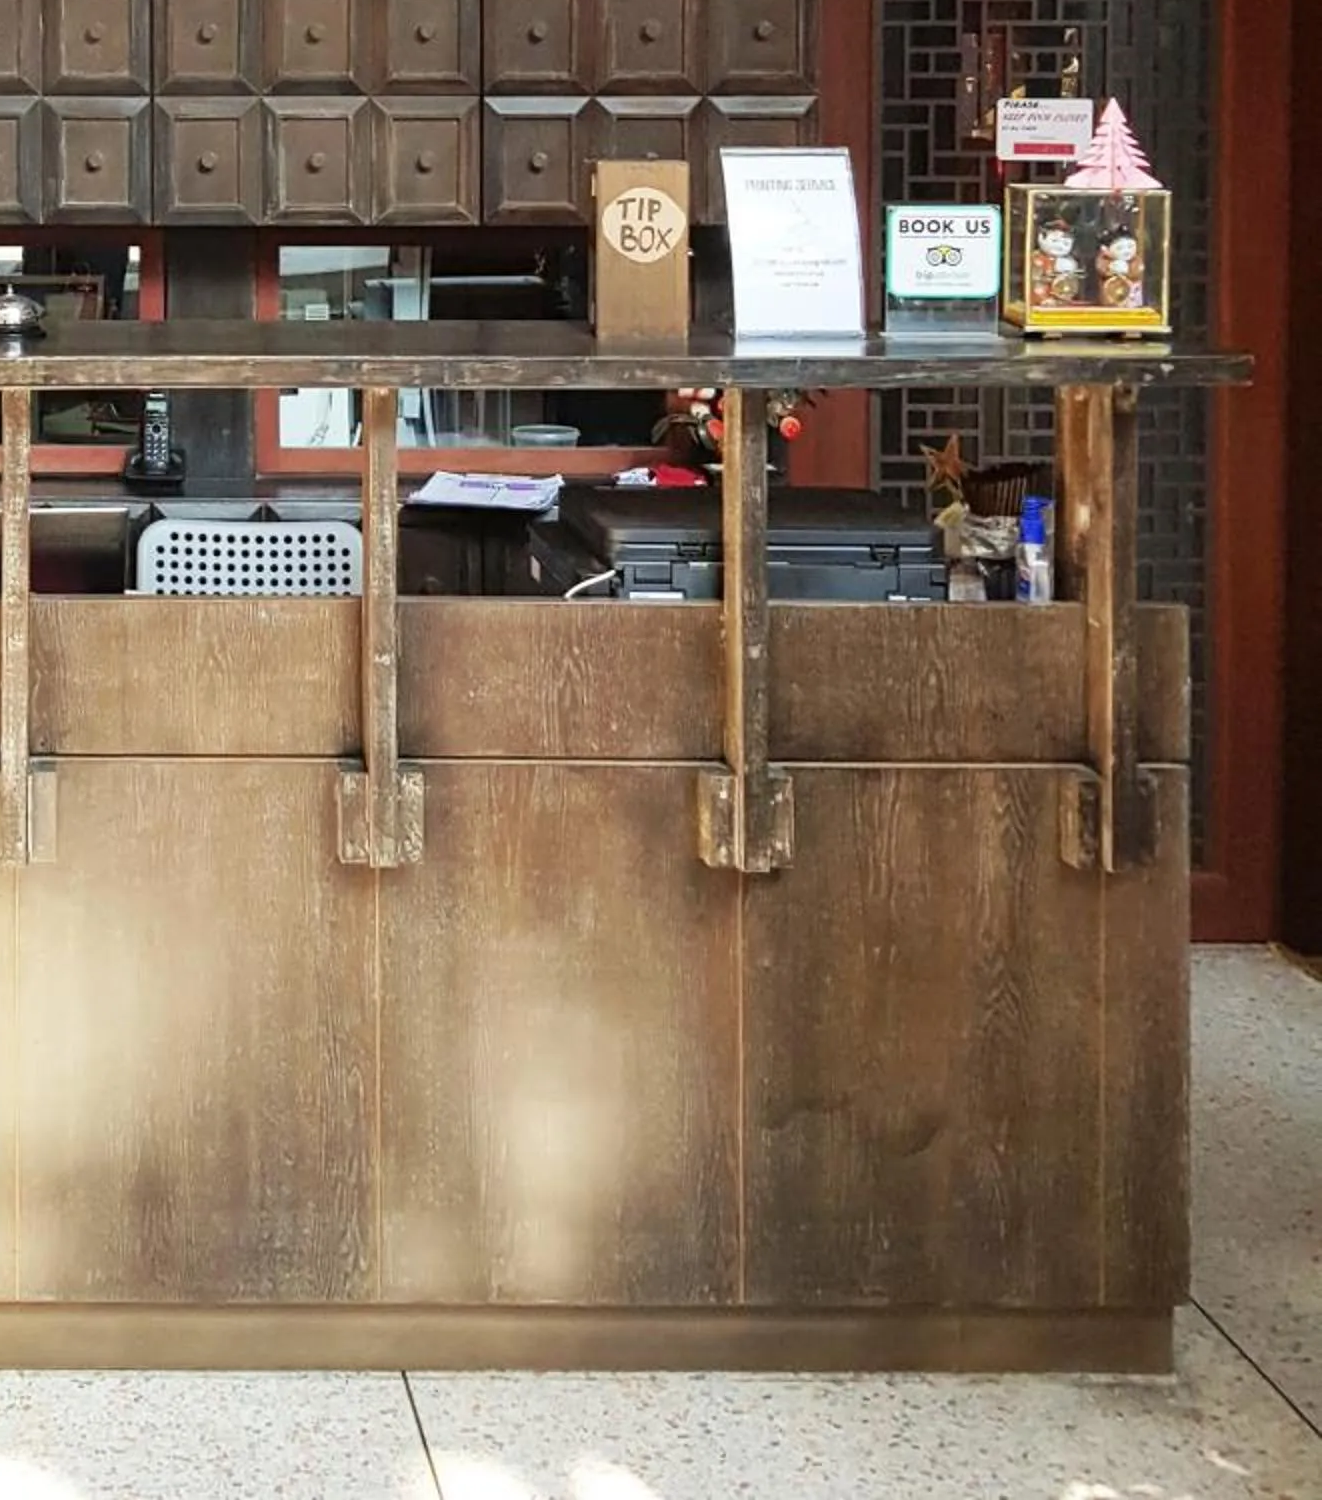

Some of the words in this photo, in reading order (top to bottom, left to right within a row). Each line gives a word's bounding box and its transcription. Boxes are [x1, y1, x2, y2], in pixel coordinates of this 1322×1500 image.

[616, 197, 663, 222] TIP
[620, 224, 673, 254] BOX
[899, 219, 955, 234] BOOK
[965, 219, 992, 235] US
